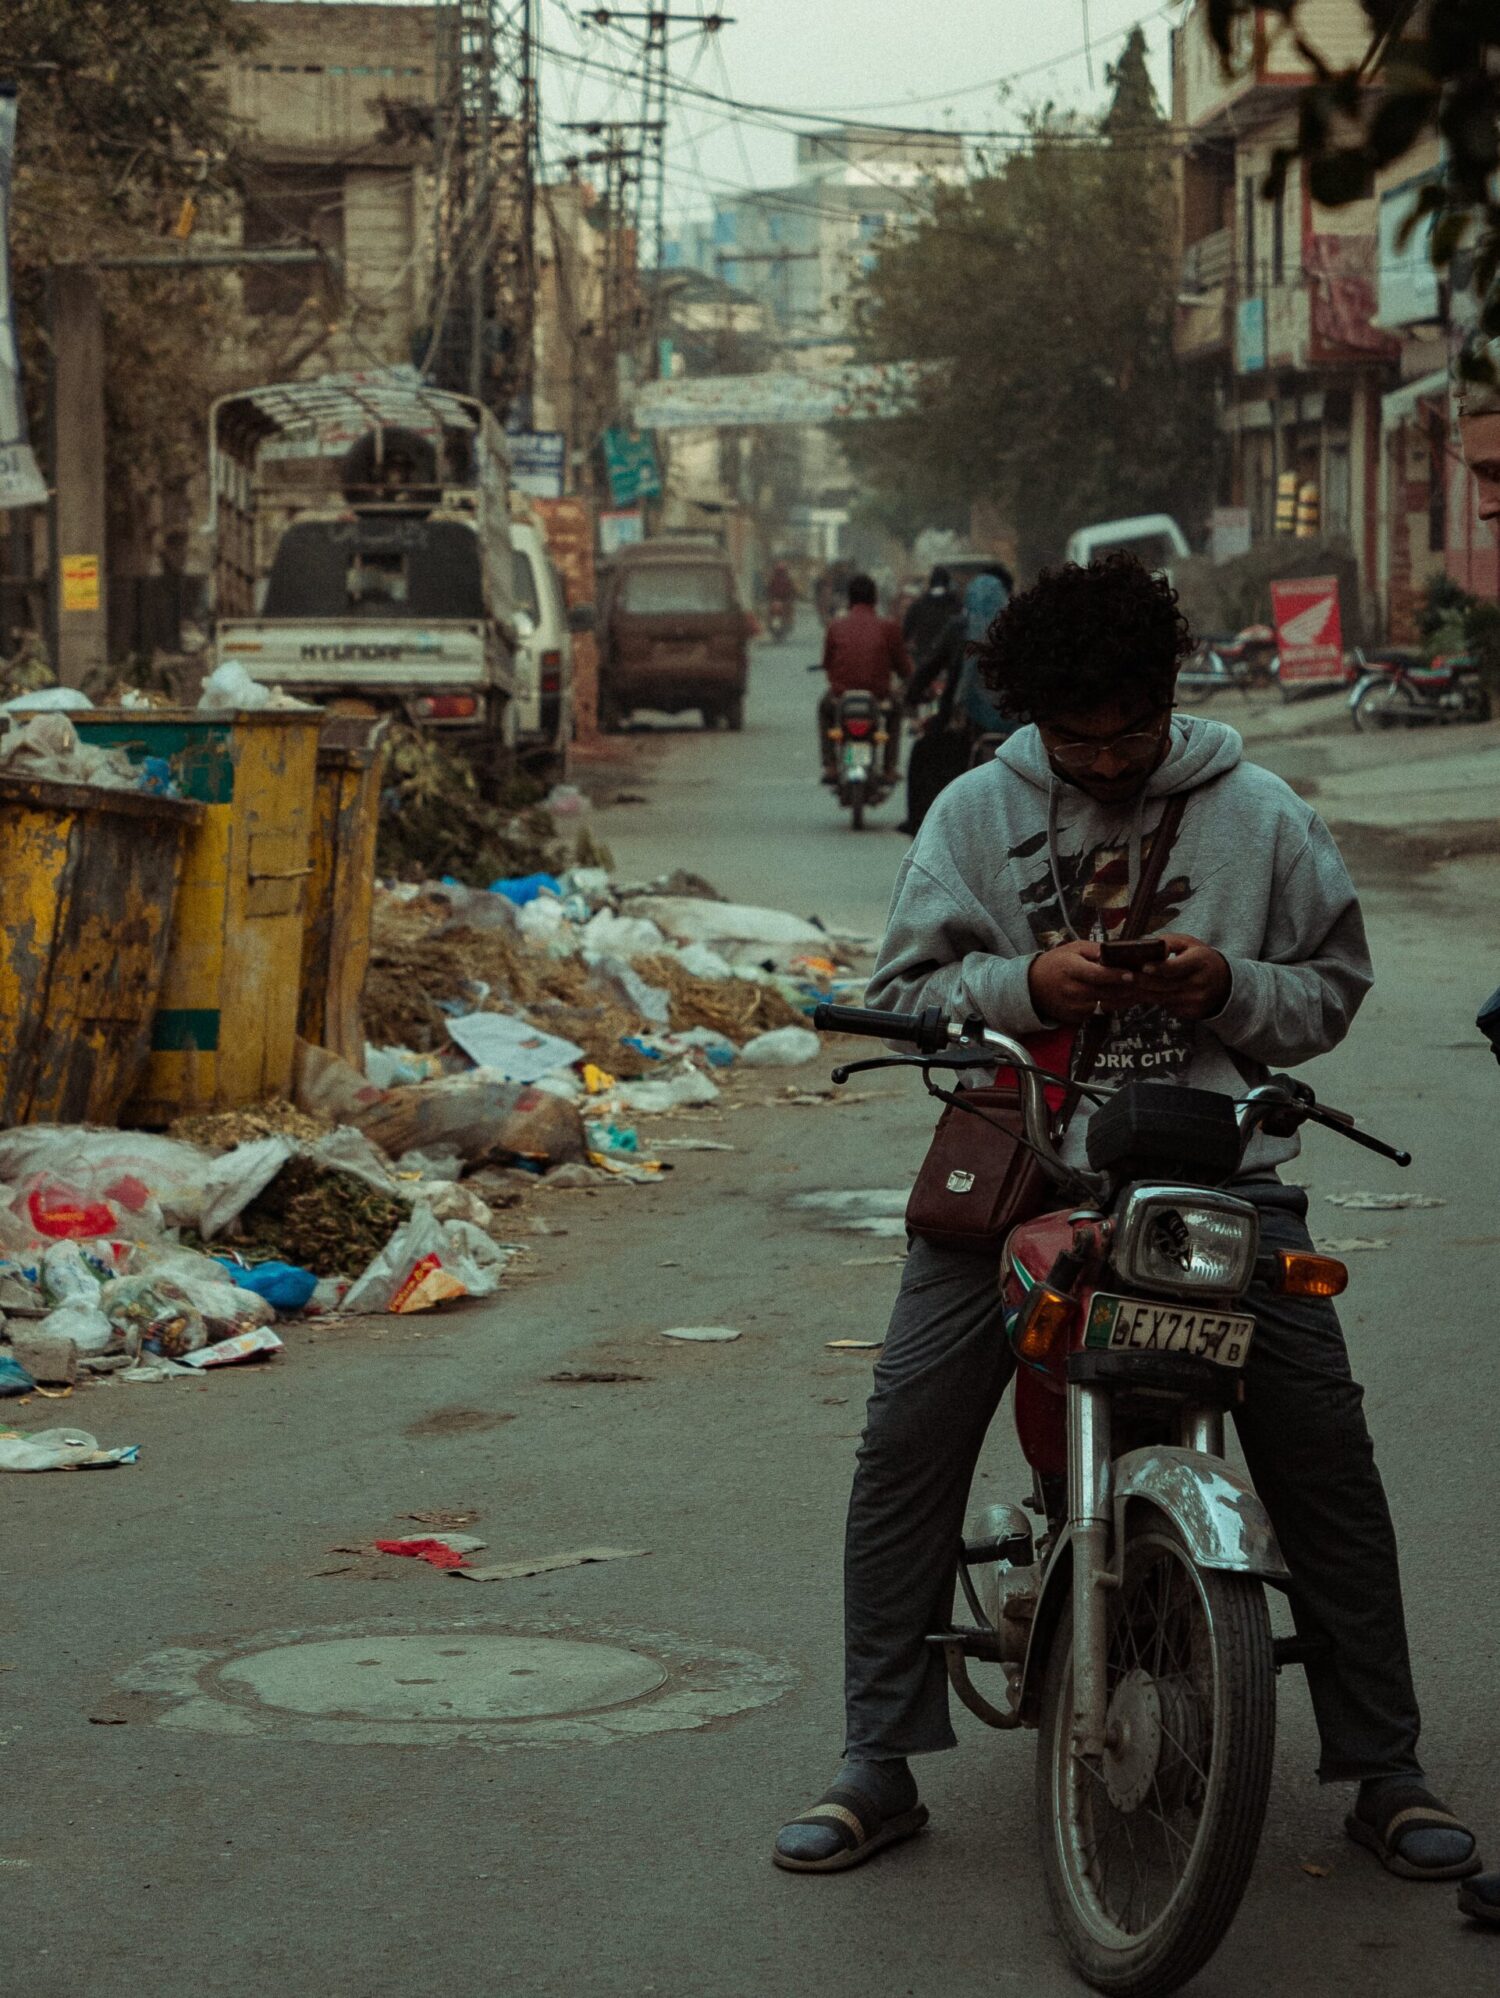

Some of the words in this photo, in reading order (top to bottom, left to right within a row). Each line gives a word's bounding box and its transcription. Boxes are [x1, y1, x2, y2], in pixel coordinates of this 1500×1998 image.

[1094, 1053, 1135, 1069] ORK
[1140, 1048, 1187, 1068] CITY
[1227, 1343, 1241, 1362] B
